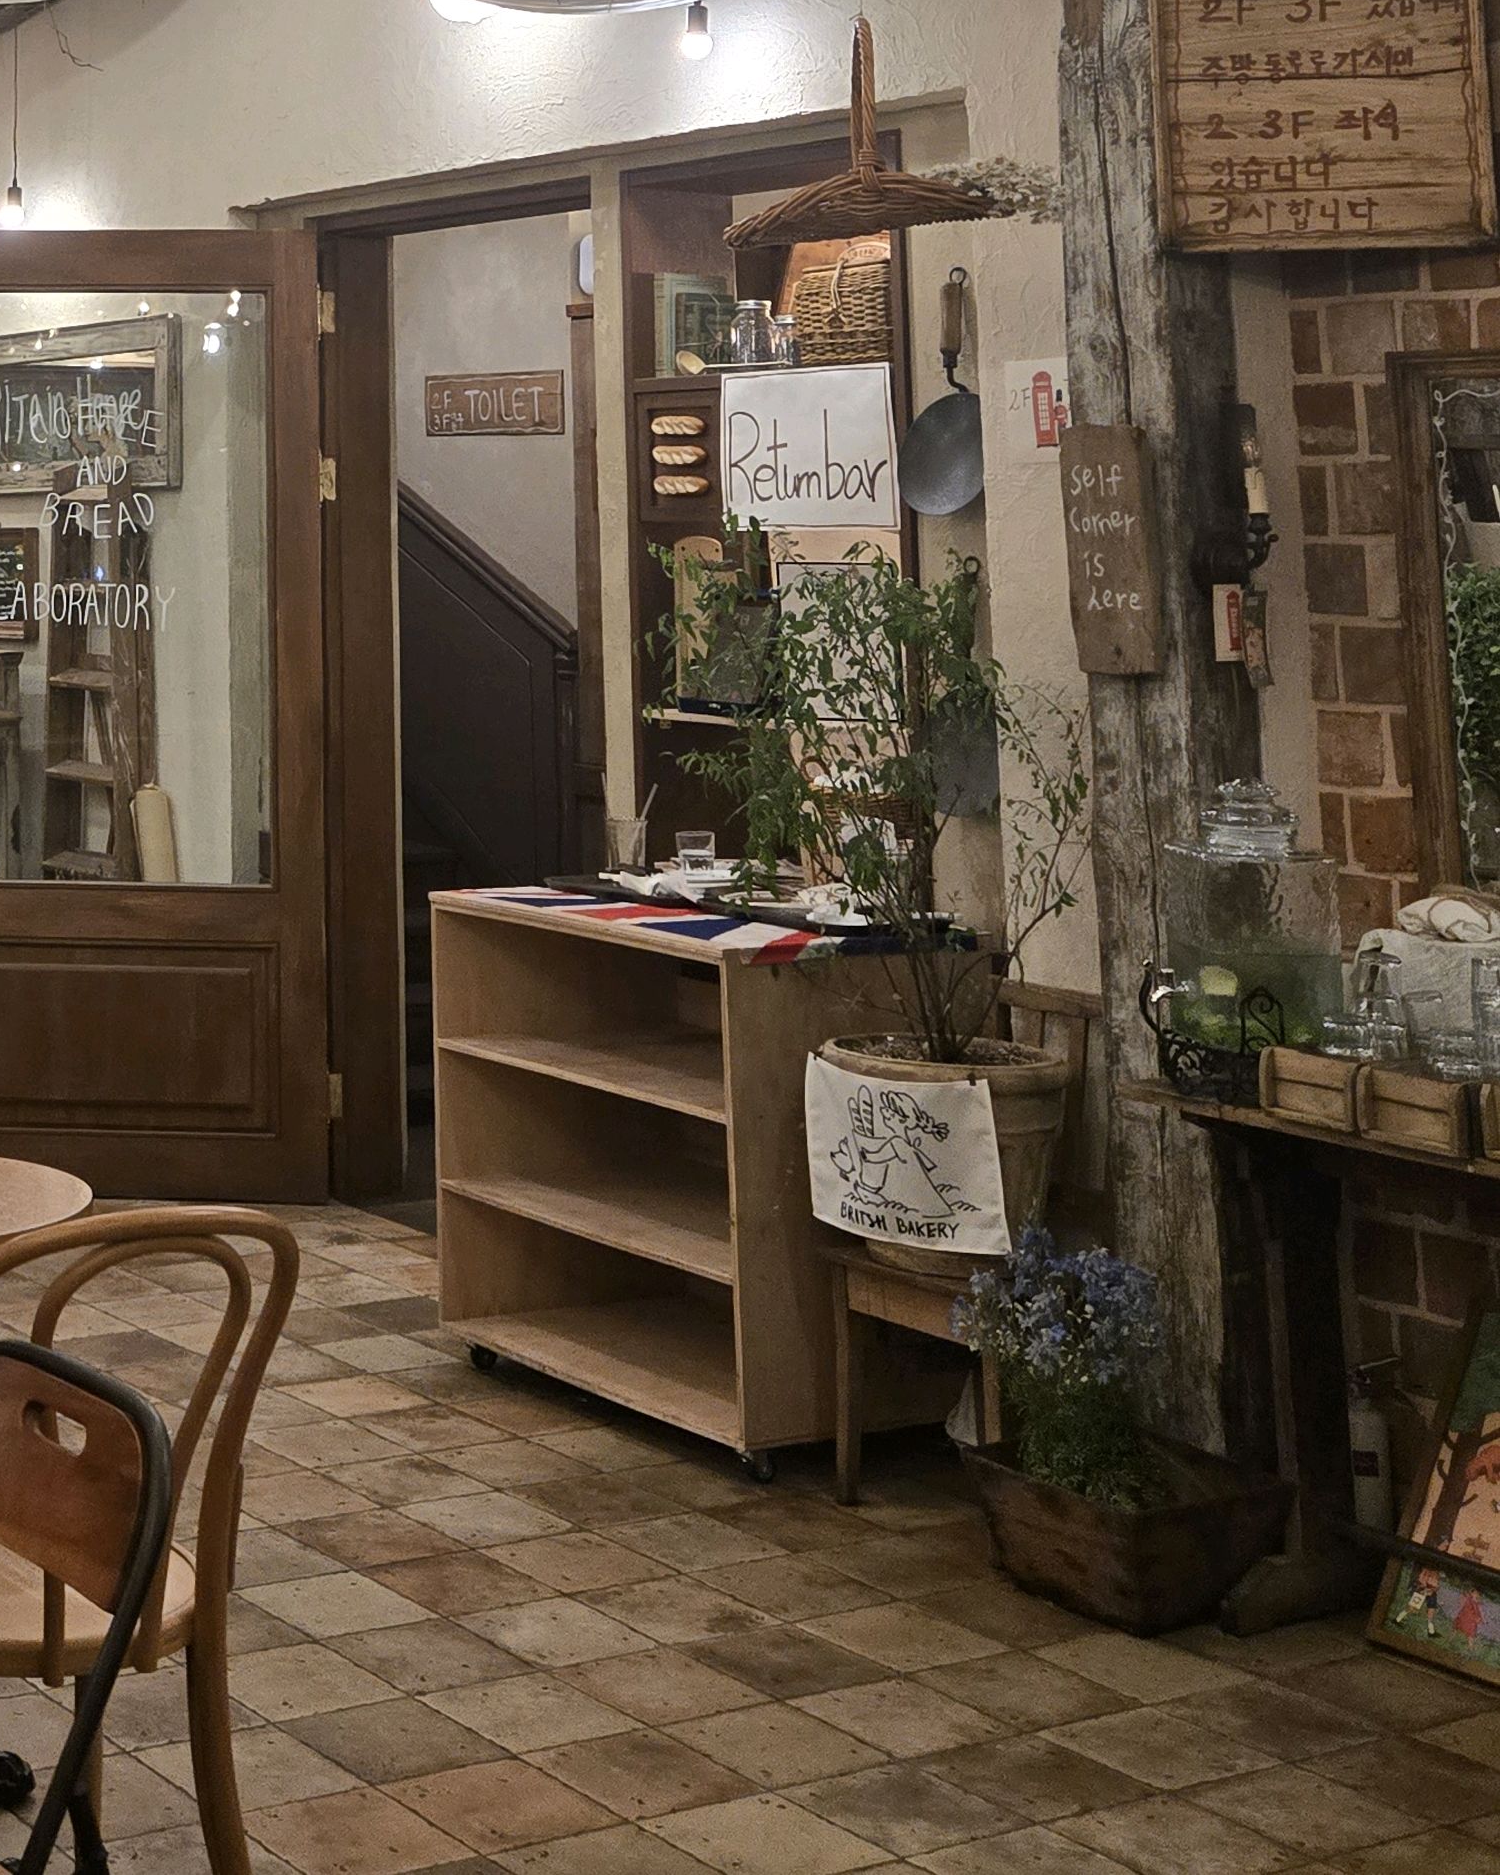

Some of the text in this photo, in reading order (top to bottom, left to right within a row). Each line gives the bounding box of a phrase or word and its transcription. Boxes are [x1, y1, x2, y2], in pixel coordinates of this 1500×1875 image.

[1258, 109, 1315, 140] 3F
[1208, 197, 1379, 234] 감사합니다
[464, 386, 544, 425] TOILET
[1008, 386, 1032, 412] 2F
[76, 455, 127, 487] AND
[39, 492, 155, 539] BREAD
[1083, 550, 1106, 579] is
[1087, 585, 1143, 611] here
[895, 1216, 960, 1239] BAKERY
